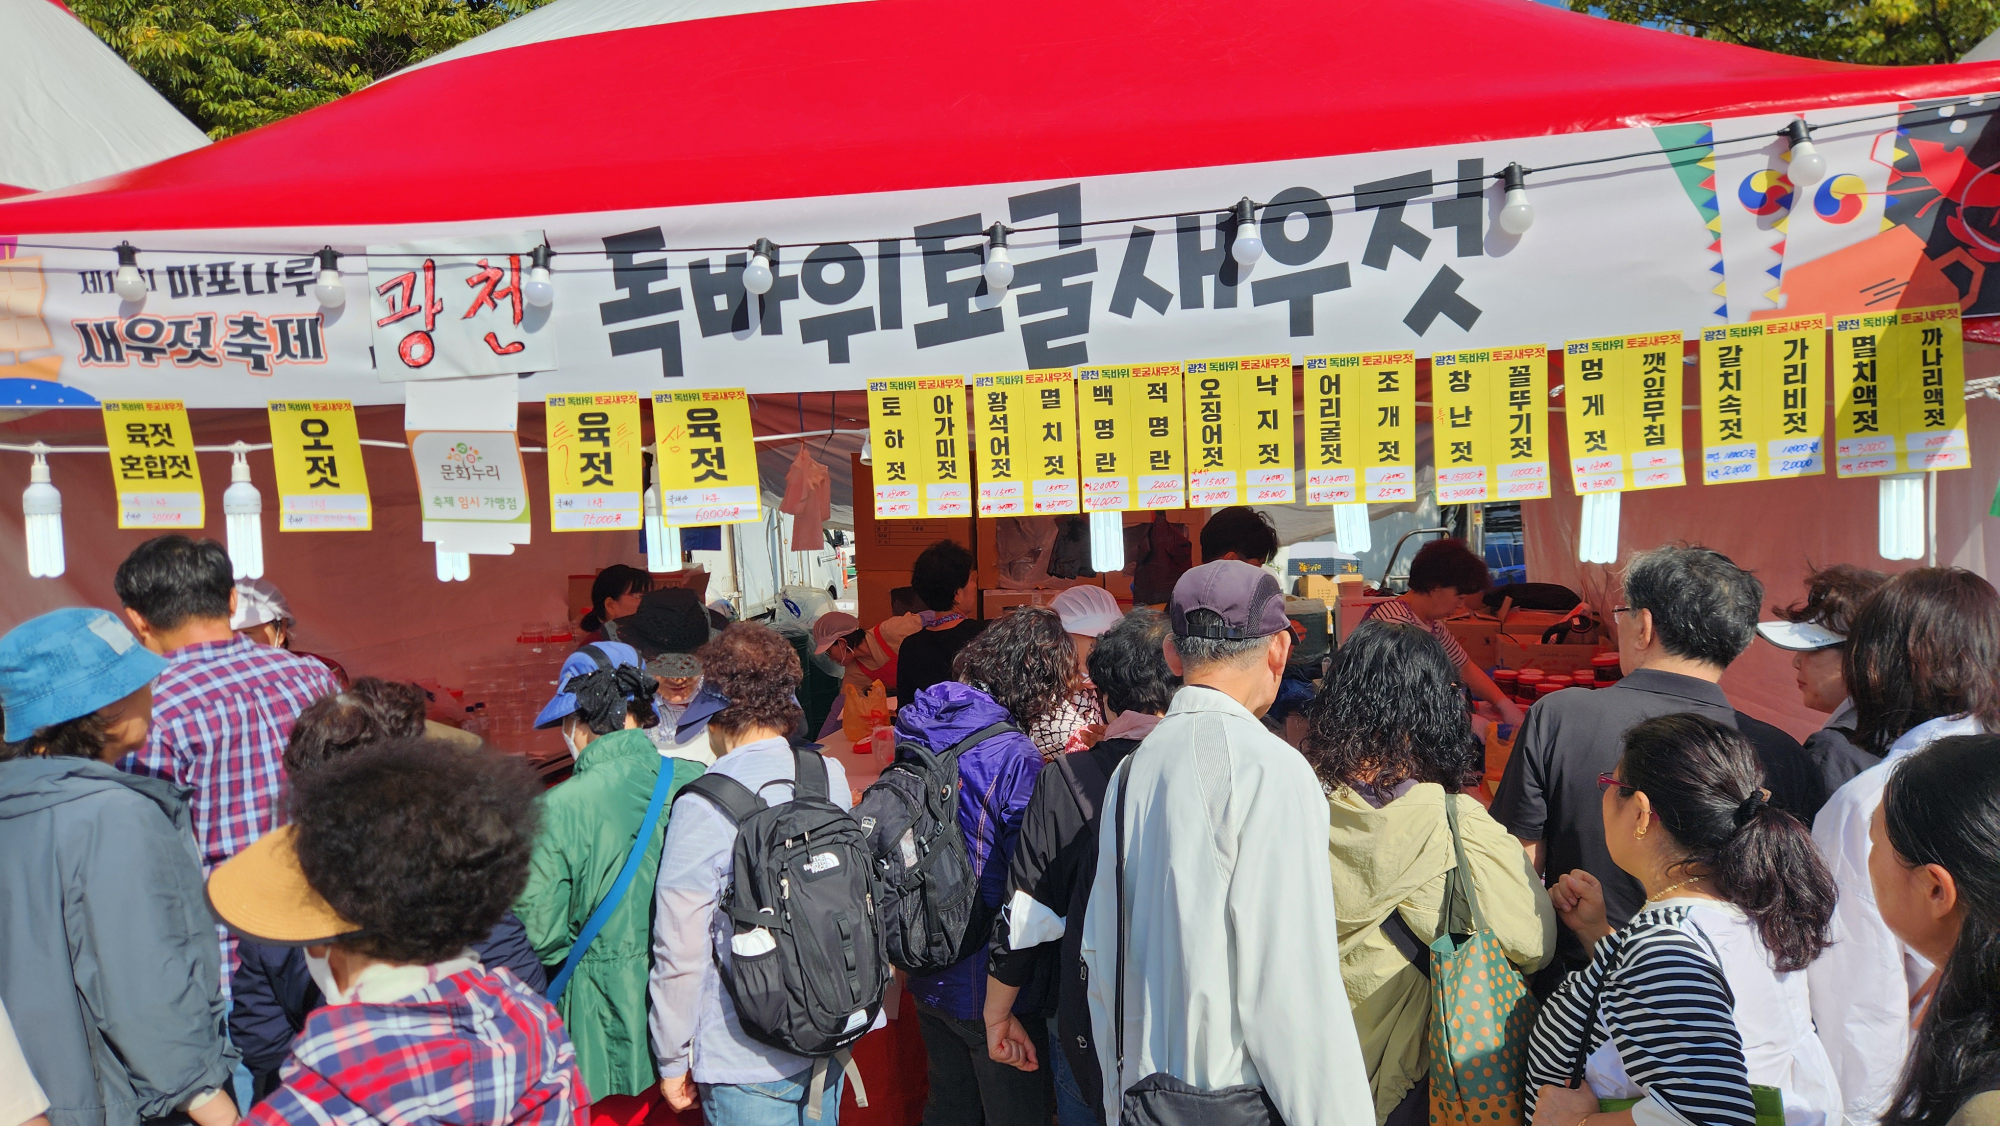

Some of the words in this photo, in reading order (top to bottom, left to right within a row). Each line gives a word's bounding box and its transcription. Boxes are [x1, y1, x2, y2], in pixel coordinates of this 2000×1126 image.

[166, 258, 318, 300] 마포나루
[375, 254, 526, 369] 광천
[75, 316, 218, 363] 새우젓
[222, 315, 324, 372] 축제
[1435, 355, 1456, 366] 광천
[1459, 352, 1489, 363] 독바위
[1567, 343, 1589, 355] 광천
[1592, 339, 1624, 351] 독바위
[1704, 329, 1726, 341] 광천
[1730, 325, 1763, 338] 독바위
[1837, 319, 1860, 331] 광천
[1863, 315, 1898, 328] 독바위
[655, 394, 672, 403] 광천
[674, 393, 700, 402] 독바위
[870, 382, 887, 391] 광천
[890, 381, 916, 390] 독바위
[976, 377, 993, 387] 광천
[996, 375, 1023, 385] 독바위
[1081, 370, 1099, 380] 광천
[1102, 369, 1130, 379] 독바위
[1187, 363, 1207, 373] 광천
[1209, 361, 1238, 372] 독바위
[1307, 358, 1327, 369] 광천
[1330, 357, 1359, 367] 독바위
[1643, 352, 1666, 447] 깻잎무침
[1718, 345, 1743, 441] 갈치속젓
[1784, 338, 1809, 435] 가리비젓
[1852, 334, 1879, 434] 멸치액젓
[1921, 327, 1945, 428] 까나리액젓
[105, 402, 120, 411] 광천
[121, 402, 145, 411] 독바위
[125, 423, 175, 448] 육젓
[271, 403, 286, 412] 광천
[288, 403, 311, 411] 독바위
[549, 397, 565, 407] 광천
[568, 396, 593, 406] 독바위
[882, 397, 906, 481] 토하젓
[933, 395, 957, 480] 아가미젓
[987, 392, 1011, 478] 황석어젓
[1041, 388, 1064, 476] 멸치젓
[1093, 385, 1116, 473] 백명란
[1147, 382, 1171, 471] 적명란
[1200, 378, 1223, 468] 오징어젓
[1256, 375, 1279, 465] 낙지젓
[1320, 374, 1342, 465] 어리굴젓
[1378, 371, 1400, 462] 조개젓
[1449, 370, 1473, 463] 창난젓
[1509, 365, 1532, 459] 꼴뚜기젓
[1581, 358, 1608, 453] 멍게젓
[120, 454, 194, 480] 혼합젓
[300, 418, 341, 489] 오젓
[441, 464, 500, 480] 문화누리
[578, 412, 614, 487] 육젓
[687, 408, 728, 483] 육젓
[433, 496, 454, 508] 축제
[458, 497, 480, 509] 임시
[484, 497, 517, 510] 가맹점
